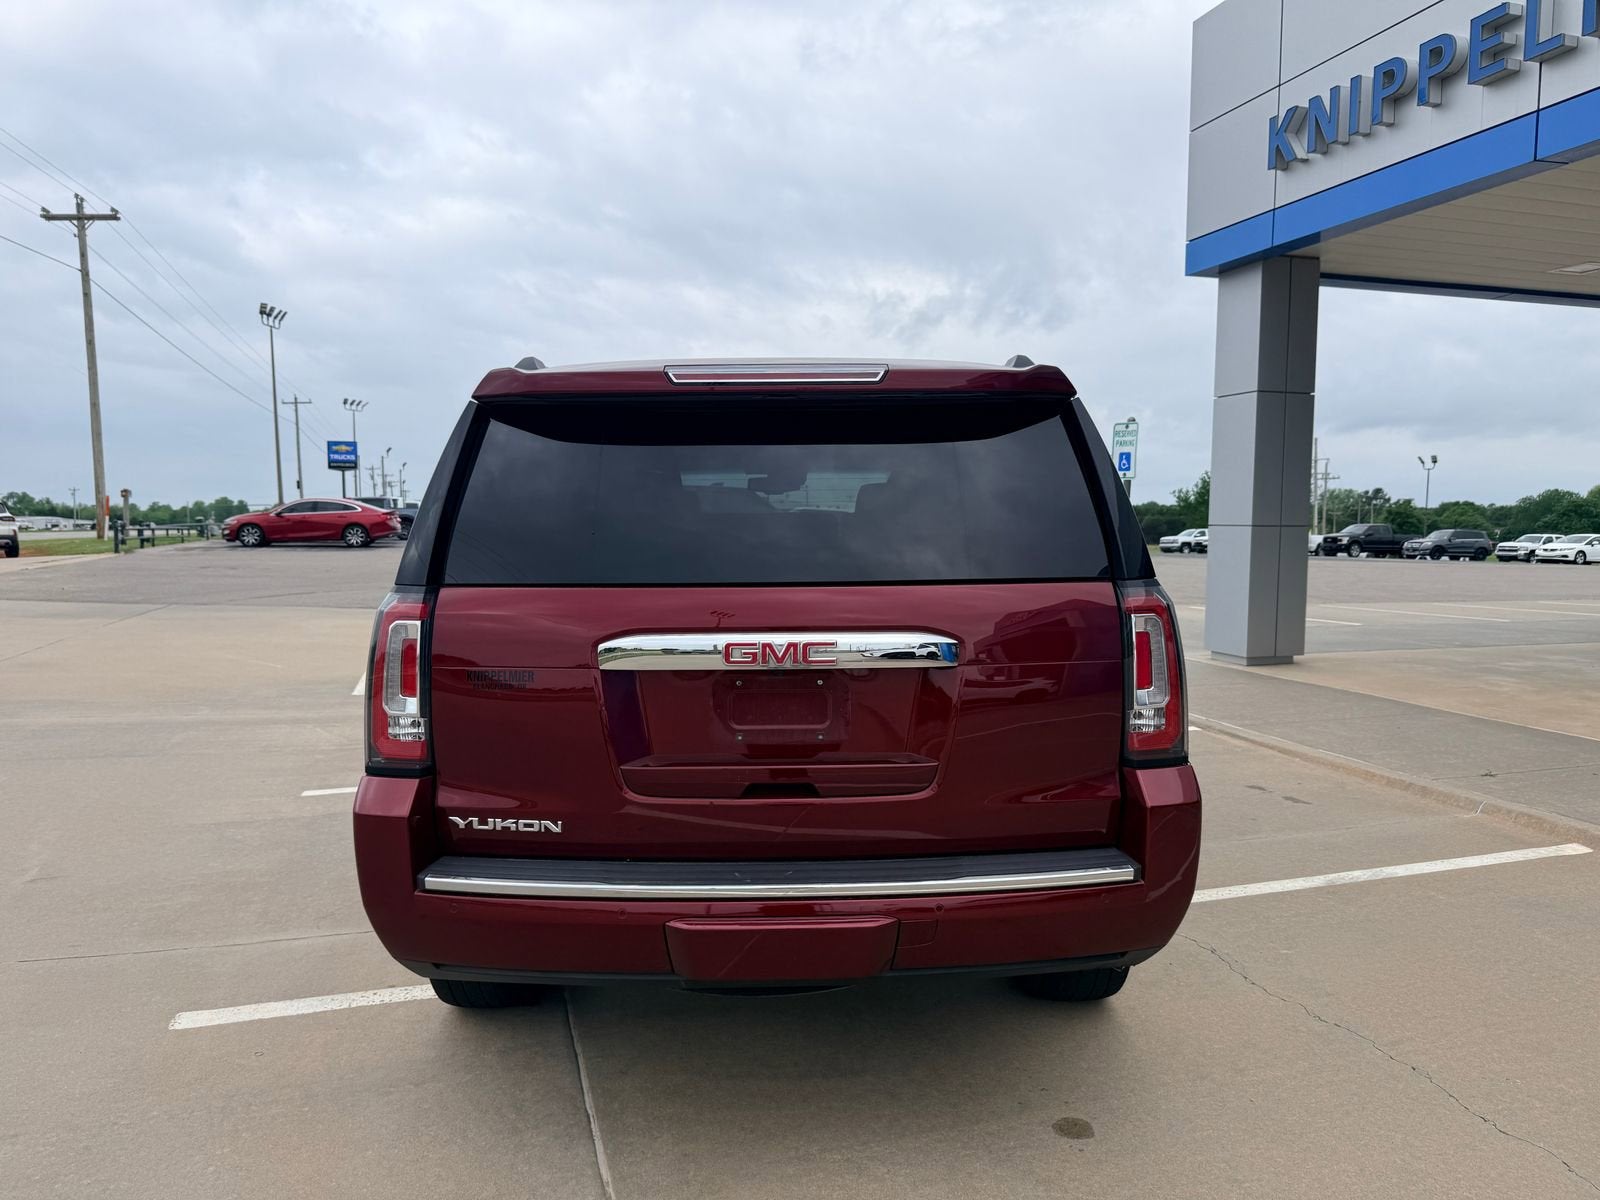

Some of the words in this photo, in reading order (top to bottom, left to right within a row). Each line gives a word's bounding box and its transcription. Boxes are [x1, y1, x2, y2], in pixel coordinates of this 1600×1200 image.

[1115, 439, 1135, 448] PARKING
[722, 640, 837, 666] GMC
[466, 670, 535, 683] KNIPPELMIER
[448, 816, 562, 833] YUKON
